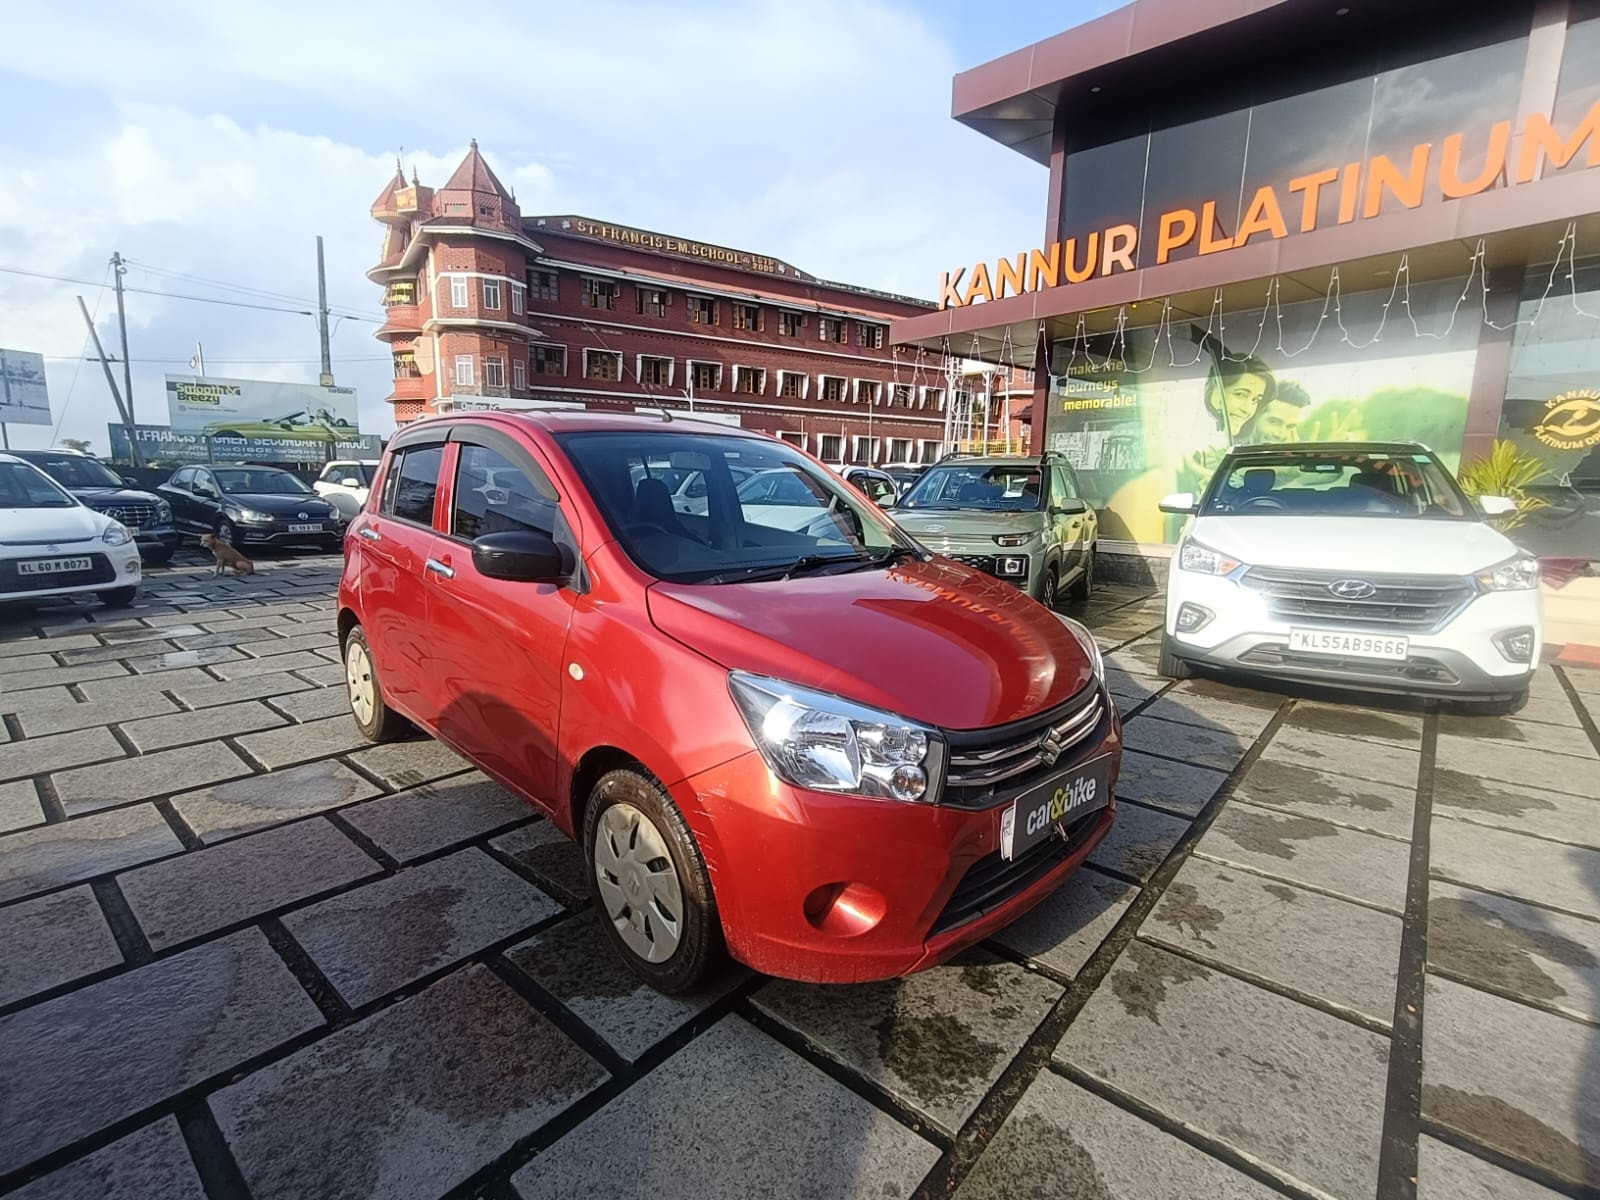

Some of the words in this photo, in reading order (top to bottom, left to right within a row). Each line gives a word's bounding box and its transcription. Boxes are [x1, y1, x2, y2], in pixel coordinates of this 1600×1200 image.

[937, 223, 1139, 311] KANNUR
[1156, 97, 1600, 265] PLATINUM
[577, 220, 598, 235] ST.
[602, 226, 663, 248] FRANCIS
[1068, 362, 1099, 375] make
[176, 383, 224, 394] Smooth
[1063, 380, 1118, 396] journeys
[177, 391, 220, 405] Breezy
[1064, 393, 1136, 411] memorable!
[1544, 389, 1600, 409] KANNU
[1533, 425, 1584, 449] PLATINUM
[21, 563, 36, 573] KL
[38, 562, 52, 571] 60
[1301, 633, 1405, 655] KL55AB9666
[1026, 776, 1096, 836] car&bike
